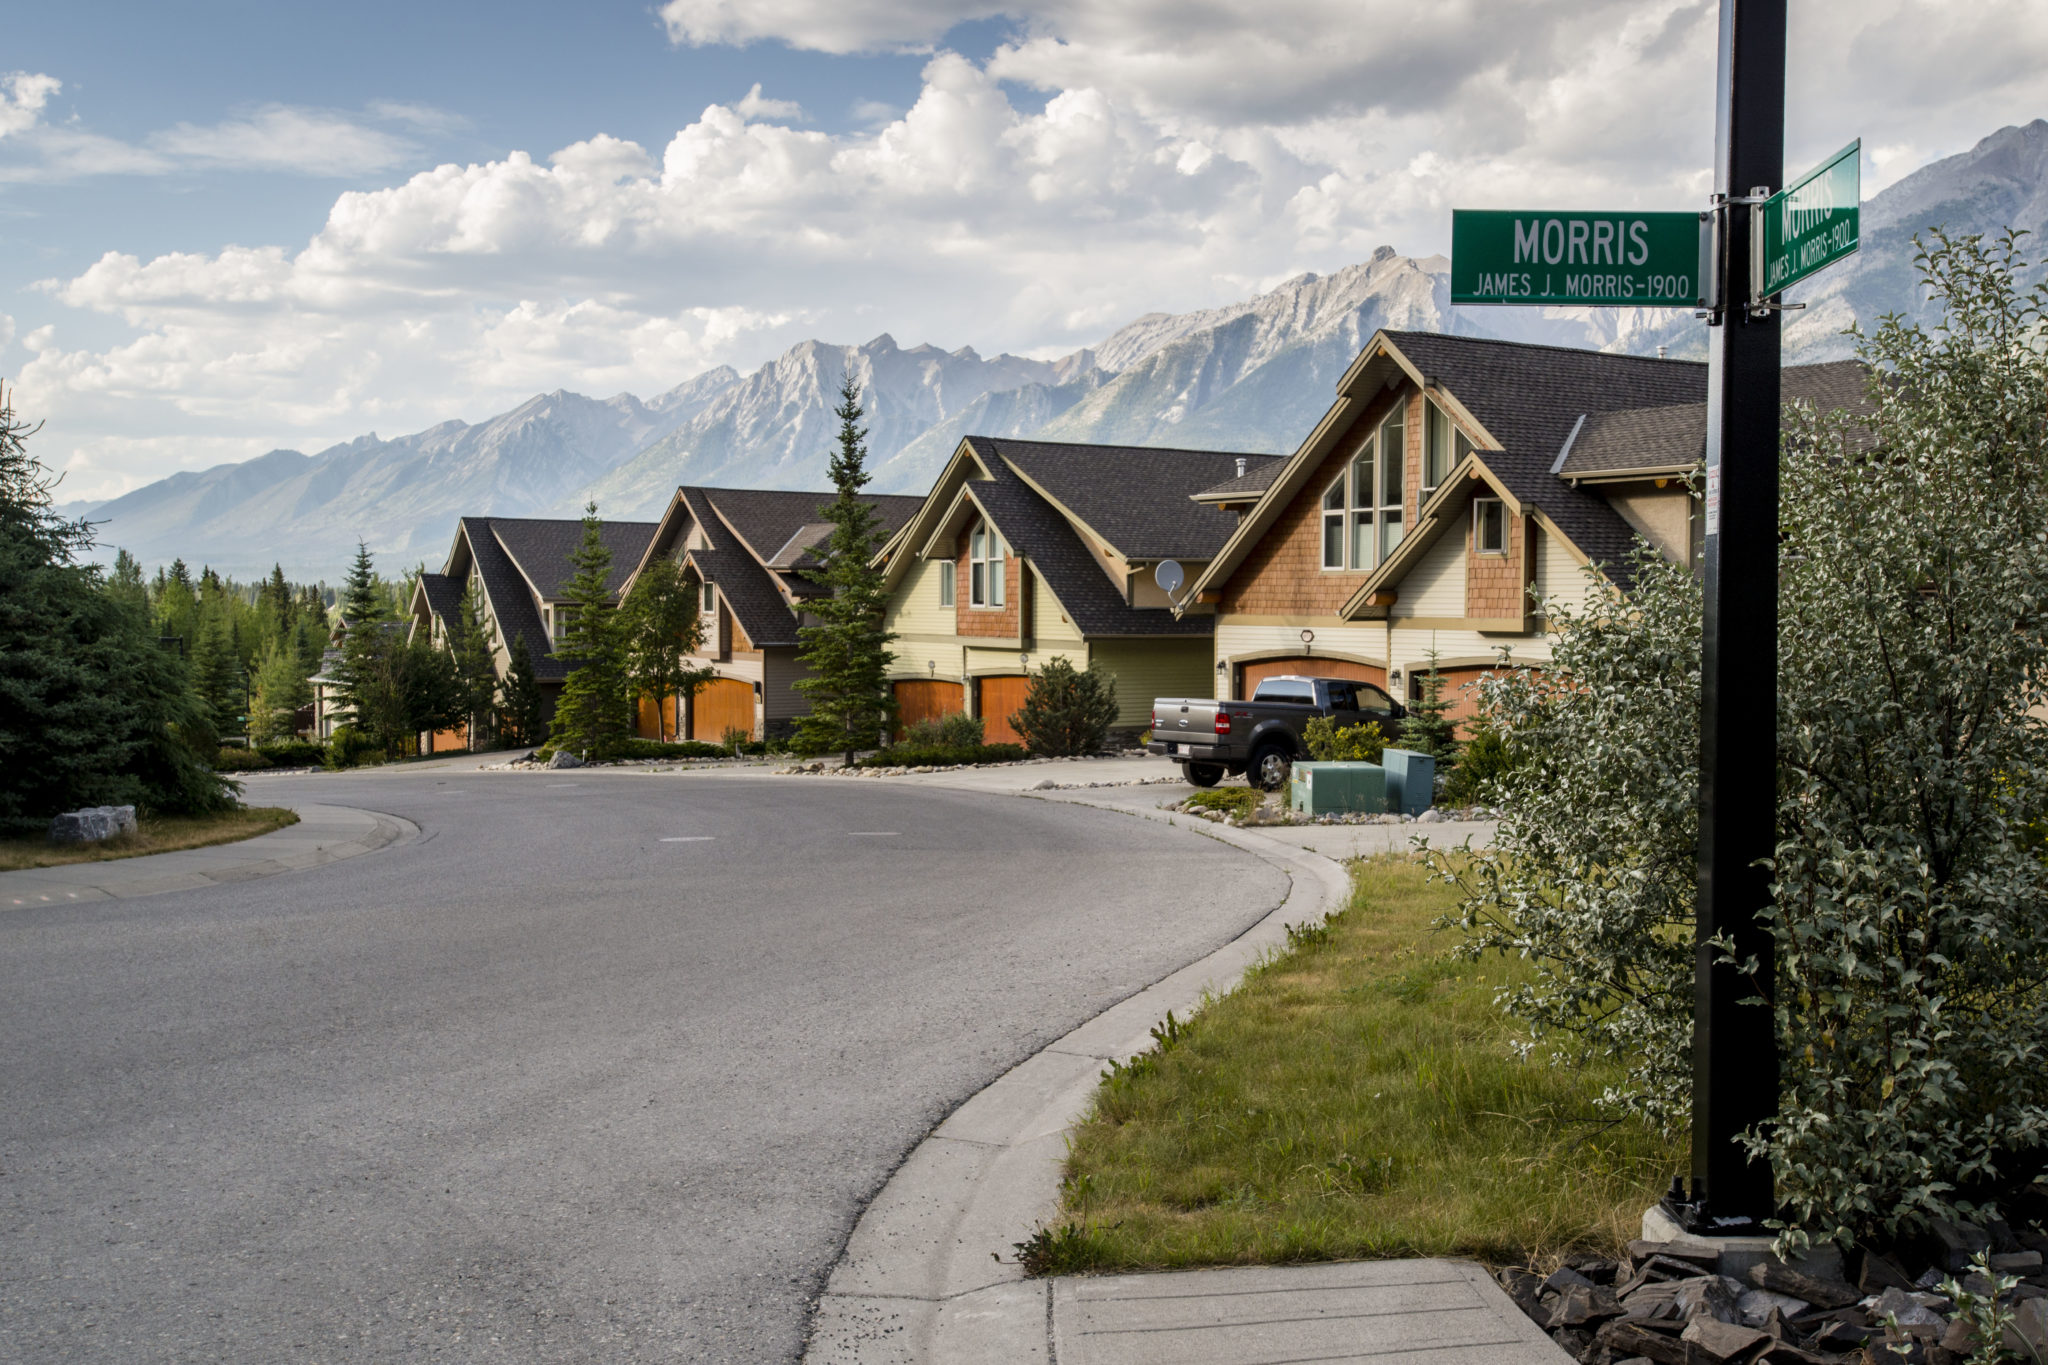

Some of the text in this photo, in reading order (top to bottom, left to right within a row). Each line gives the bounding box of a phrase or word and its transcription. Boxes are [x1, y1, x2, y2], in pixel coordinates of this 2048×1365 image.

[1782, 169, 1833, 246] MORRIS
[1513, 219, 1649, 266] MORRIS
[1473, 273, 1689, 299] JAMES J. MORRIS-1900
[1768, 254, 1789, 288] JAMES
[1791, 249, 1798, 275] J.
